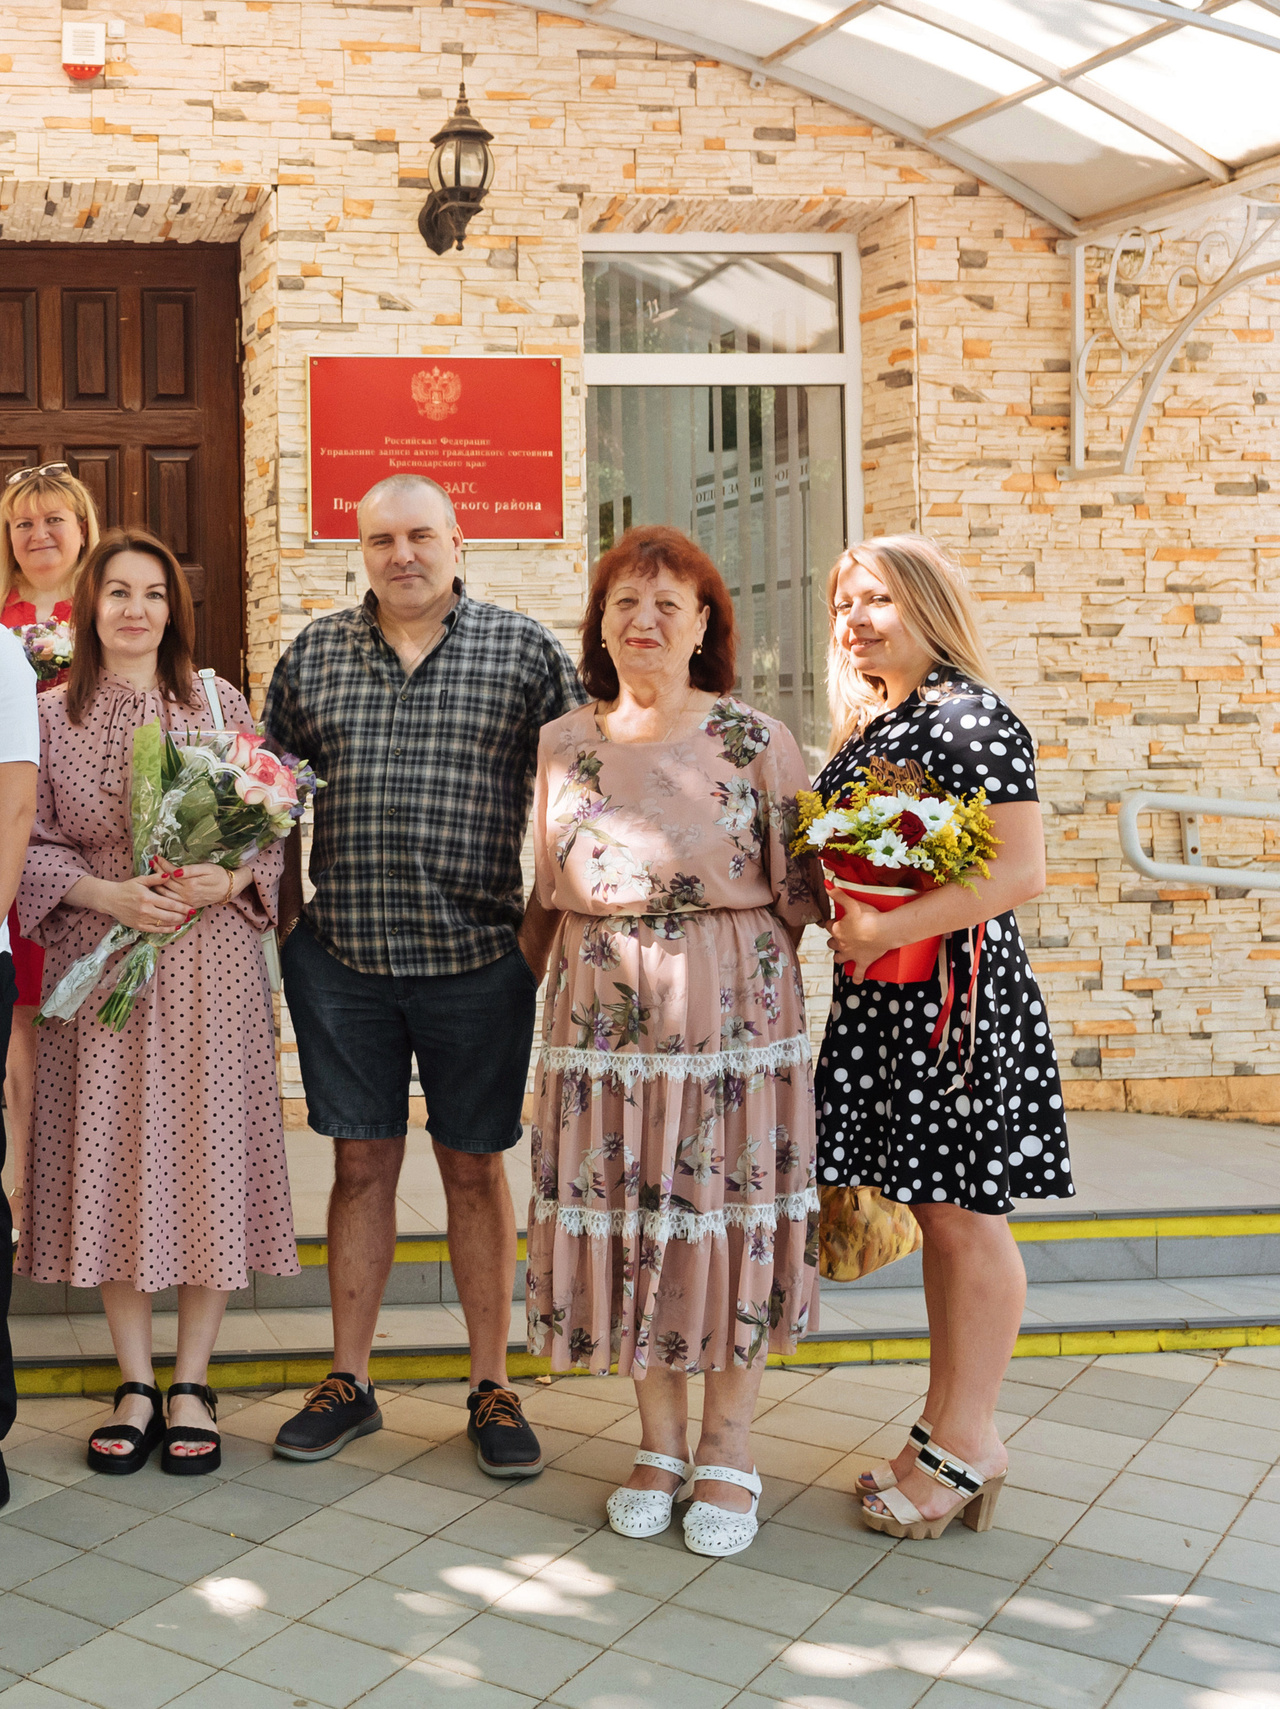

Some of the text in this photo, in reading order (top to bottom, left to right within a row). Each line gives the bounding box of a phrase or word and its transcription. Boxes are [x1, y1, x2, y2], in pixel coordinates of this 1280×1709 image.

[384, 436, 491, 447] Российская Федерация
[320, 447, 376, 458] Управление
[442, 449, 504, 459] гражданского
[389, 458, 487, 469] Краснодарского края
[443, 481, 478, 494] ЗАГС
[494, 498, 542, 514] района
